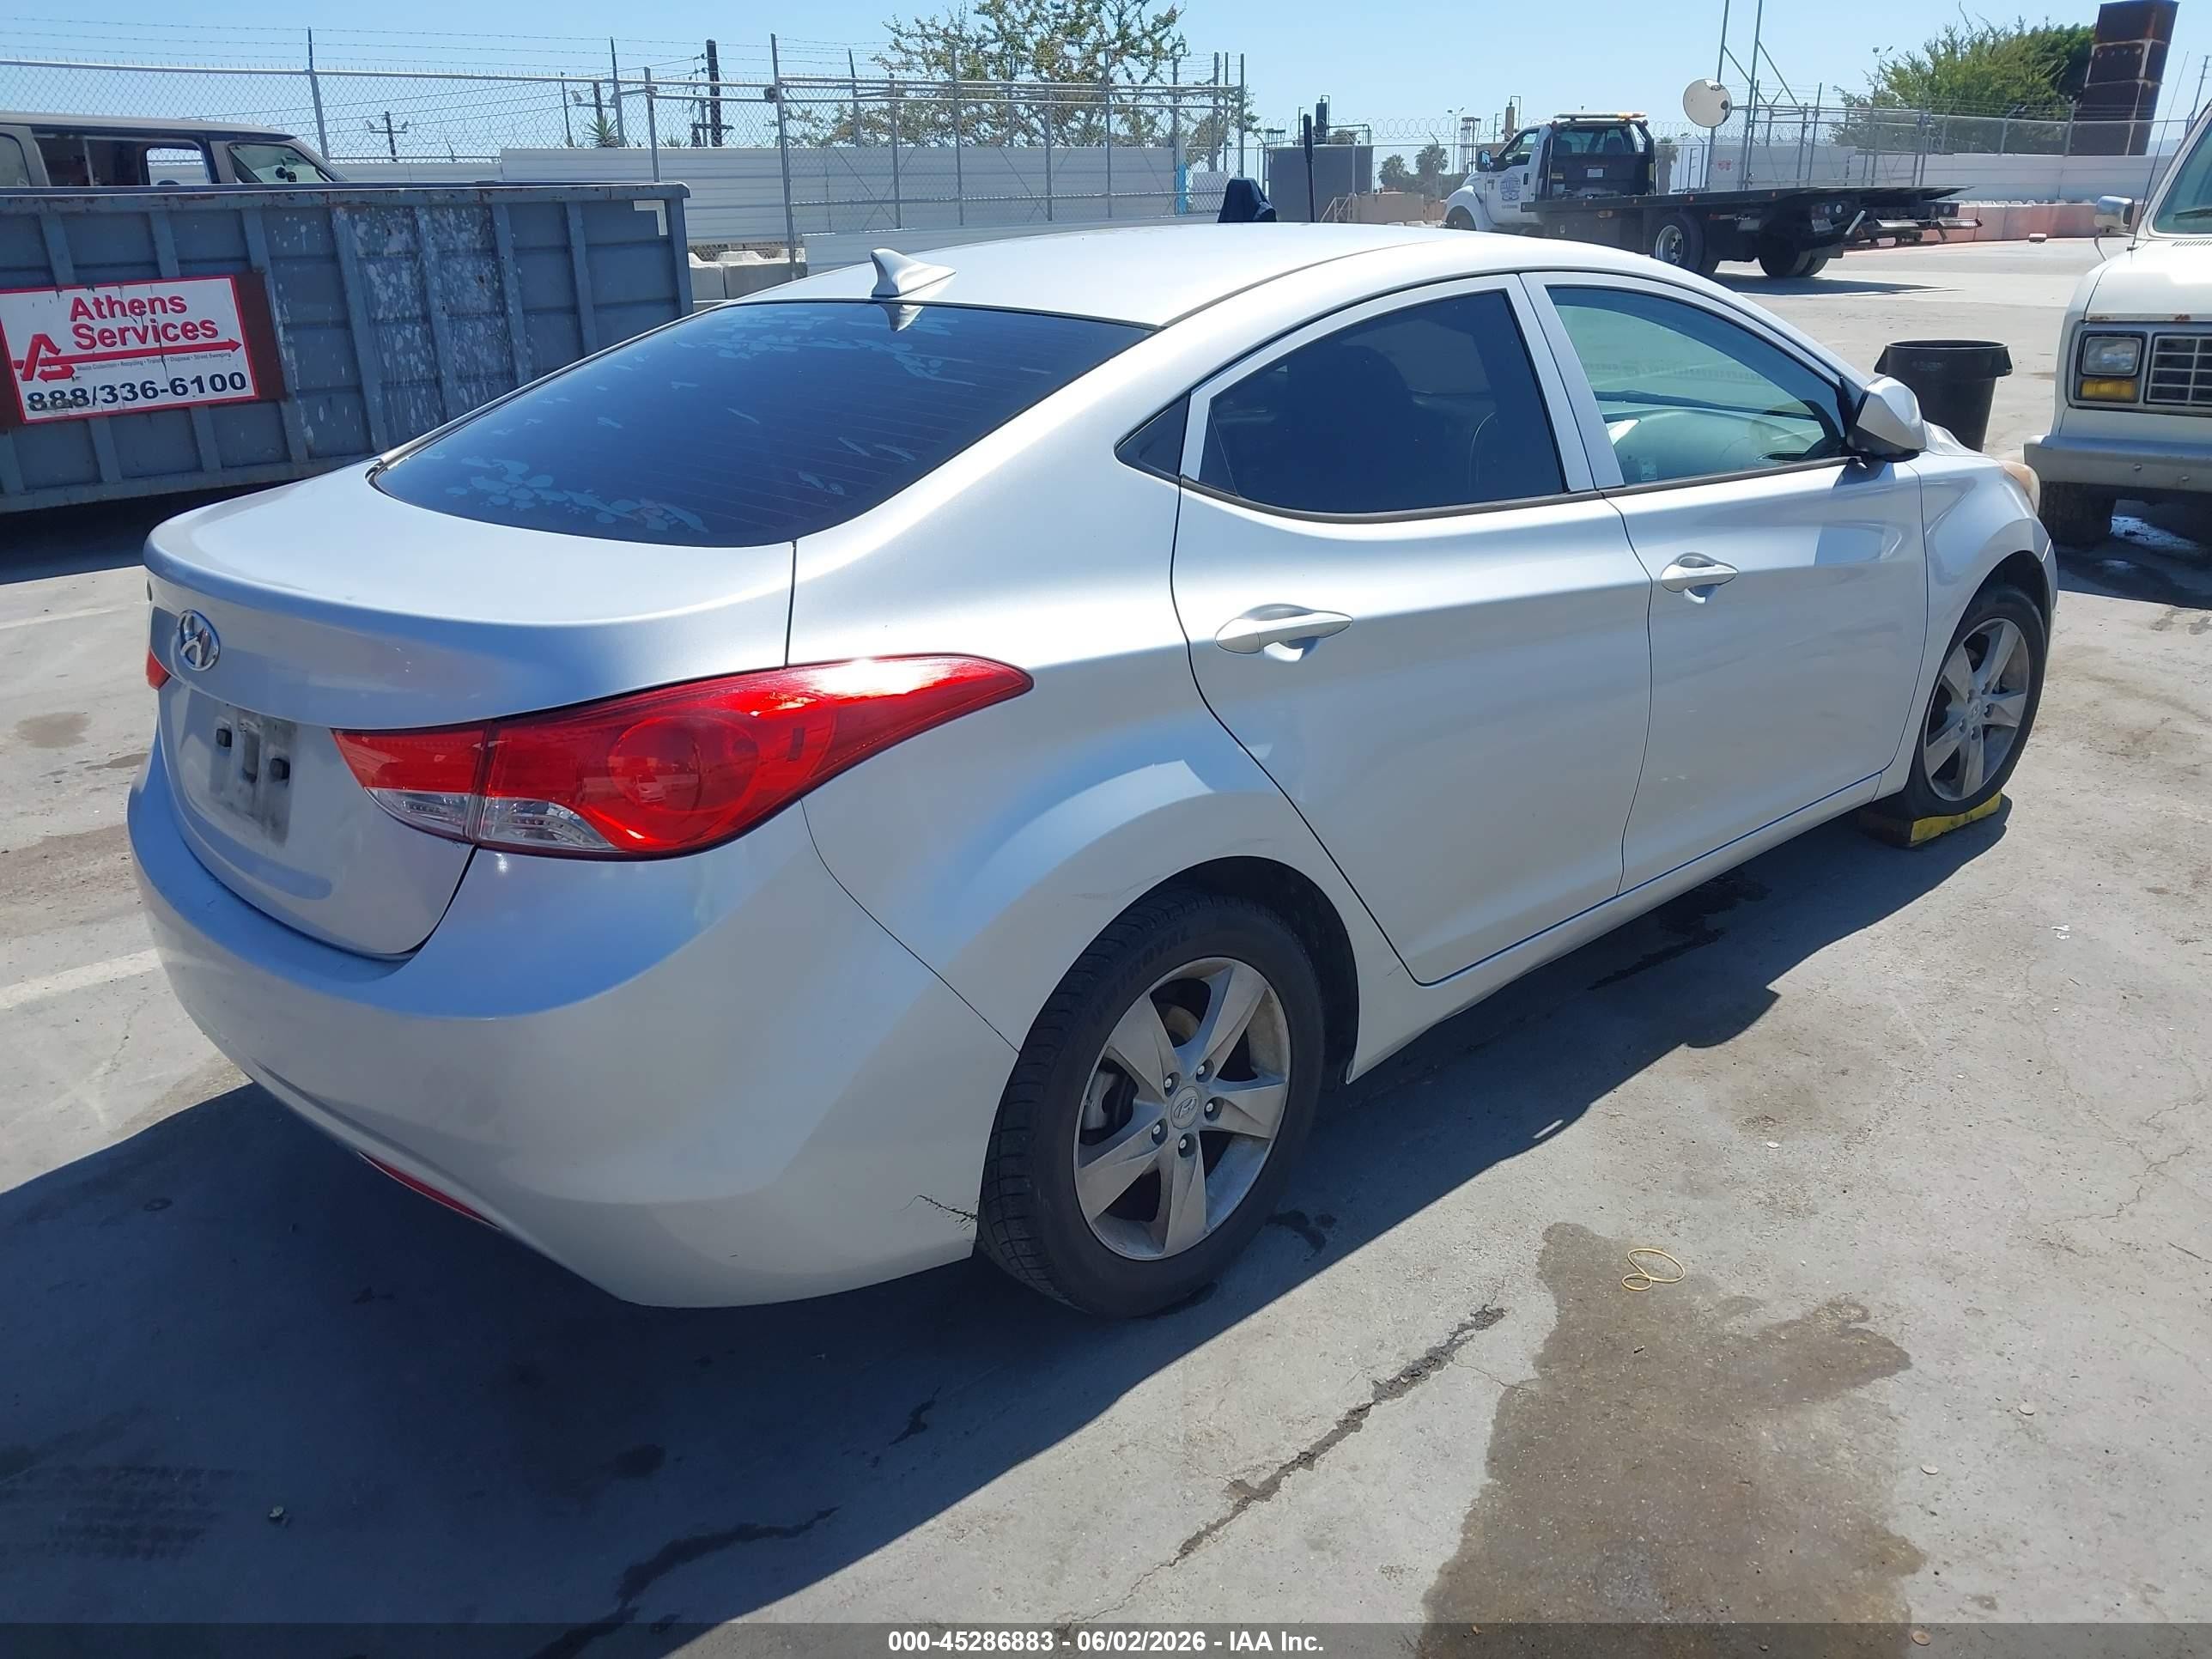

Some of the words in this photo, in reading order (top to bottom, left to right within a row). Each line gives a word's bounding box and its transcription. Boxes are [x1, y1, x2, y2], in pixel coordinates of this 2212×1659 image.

[70, 295, 187, 322] Athens
[72, 319, 219, 350] Services
[27, 371, 247, 411] 888/336-6100
